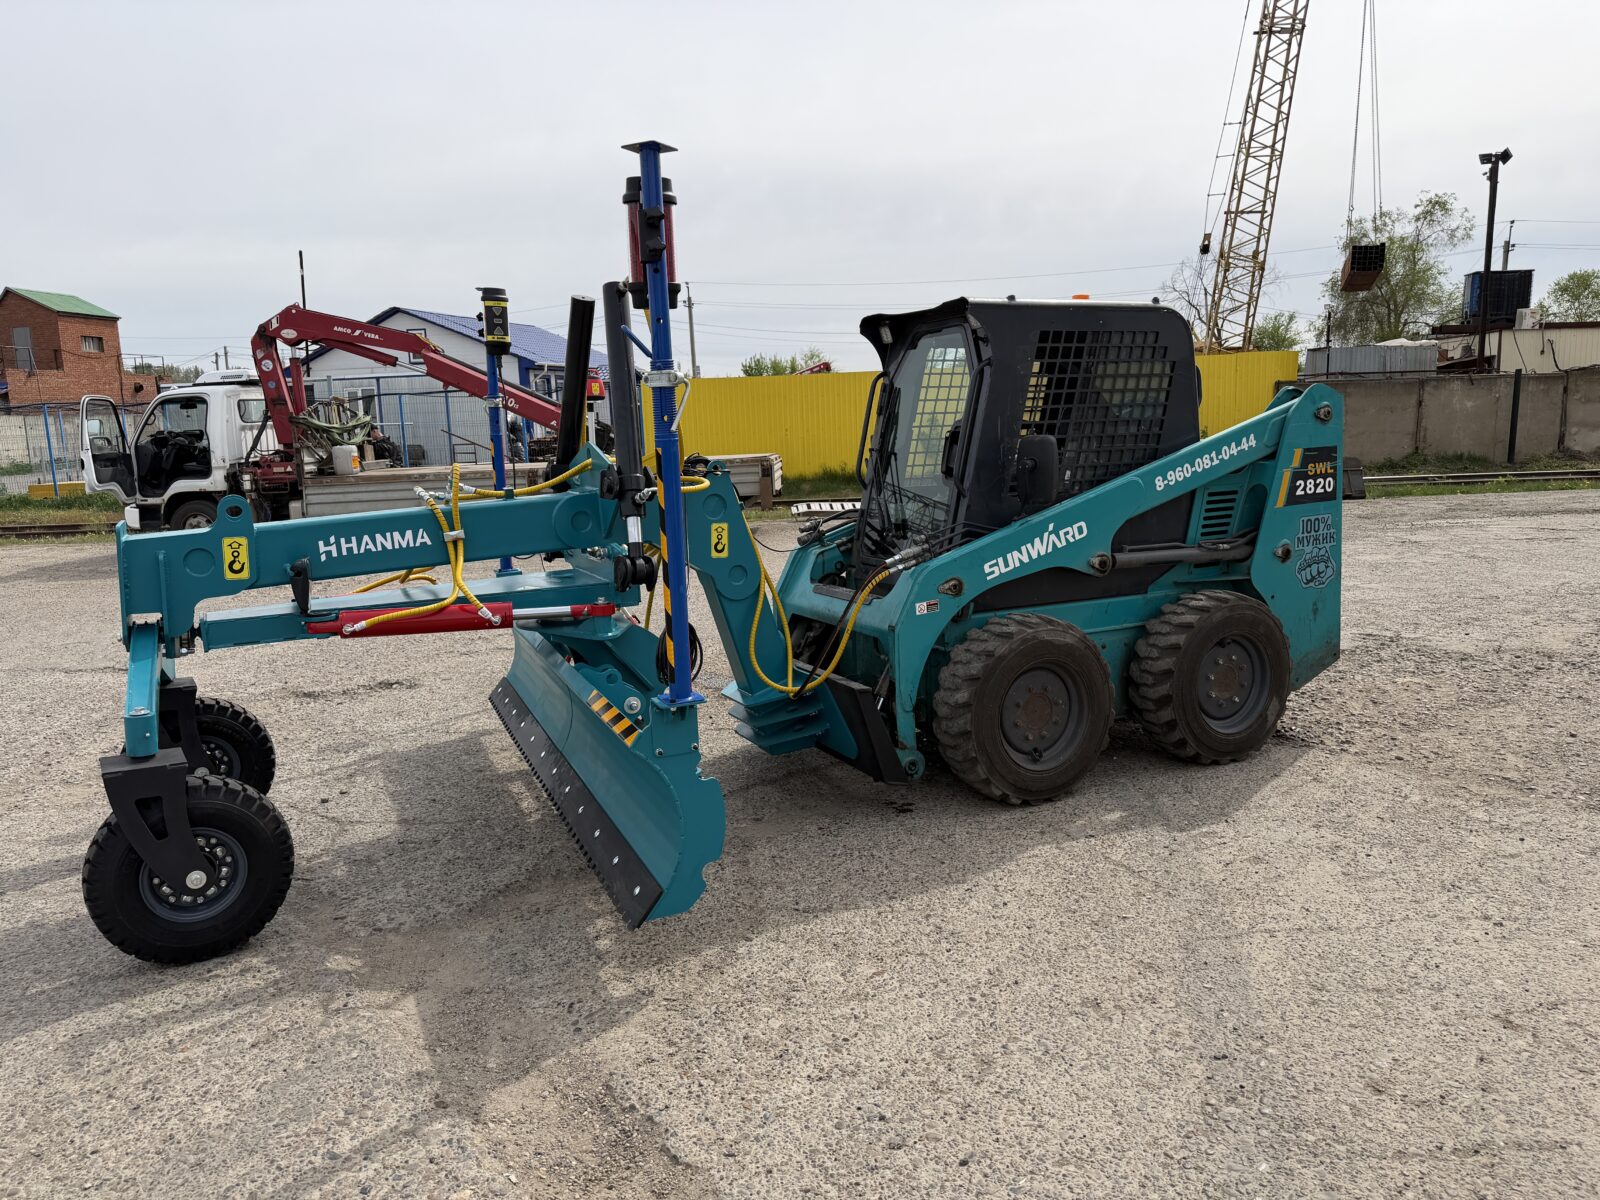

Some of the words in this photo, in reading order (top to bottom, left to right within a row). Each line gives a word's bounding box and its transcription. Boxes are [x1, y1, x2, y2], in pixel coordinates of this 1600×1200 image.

[1154, 433, 1257, 491] 8-960-081-04-44
[1307, 461, 1334, 476] SWL
[1295, 477, 1334, 496] 2820
[1301, 516, 1332, 535] 100%
[1296, 532, 1335, 548] МУЖИК
[983, 521, 1088, 580] SUNWARD
